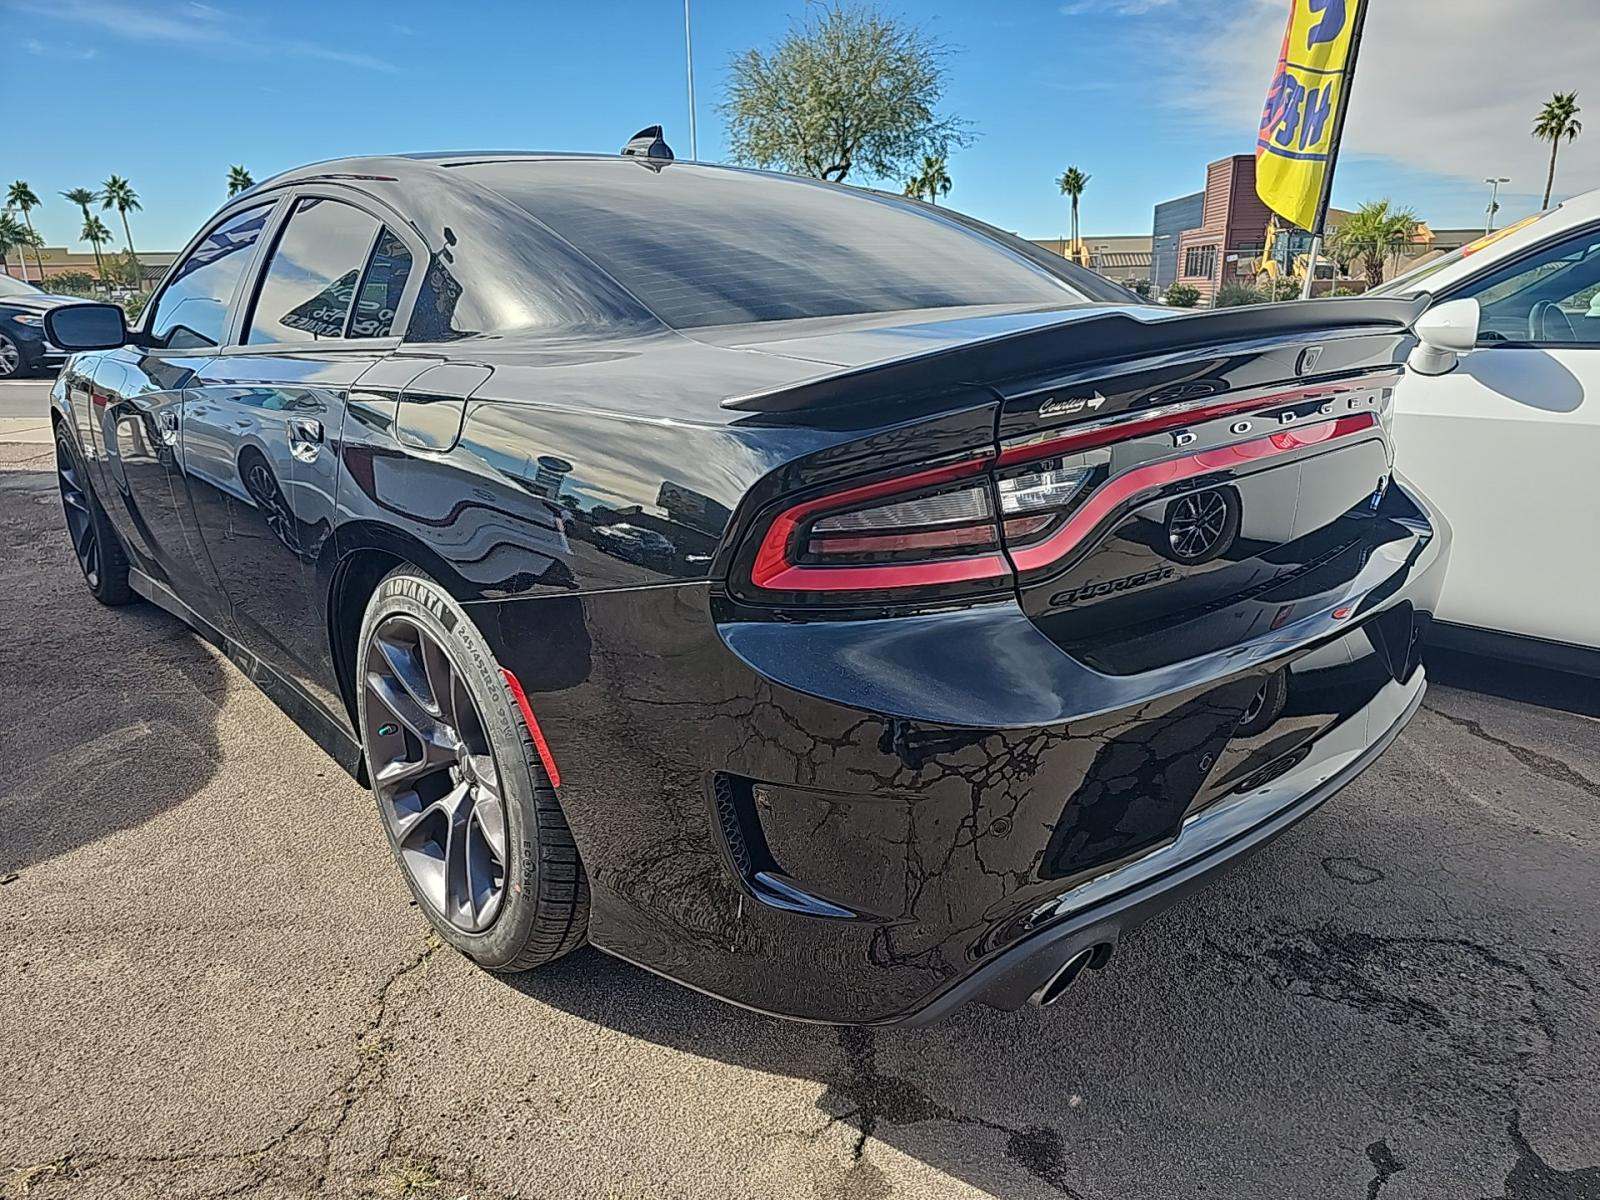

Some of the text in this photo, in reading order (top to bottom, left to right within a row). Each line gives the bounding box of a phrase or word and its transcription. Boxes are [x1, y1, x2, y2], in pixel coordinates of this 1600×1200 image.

[1173, 397, 1362, 449] DODGE
[384, 579, 444, 620] ADVANTA
[458, 625, 500, 702] 245/45ZR20
